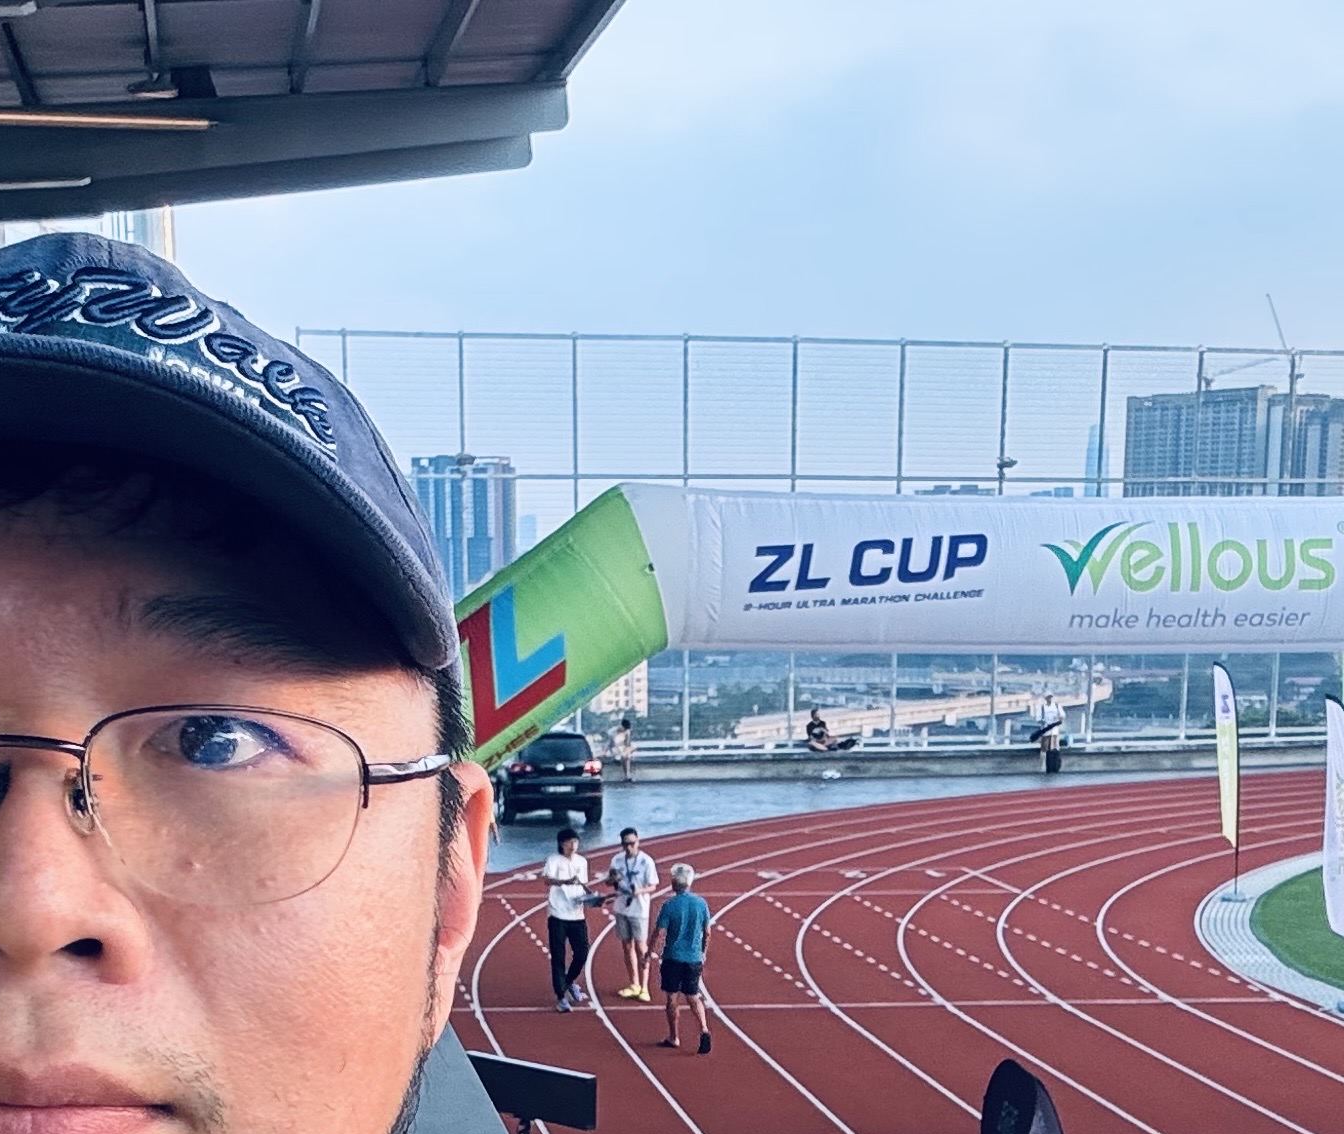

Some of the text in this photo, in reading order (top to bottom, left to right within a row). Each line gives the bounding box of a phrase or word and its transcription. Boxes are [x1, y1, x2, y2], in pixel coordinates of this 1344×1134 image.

[747, 533, 989, 594] ZL CUP
[1039, 520, 1336, 597] Wellous
[795, 598, 836, 609] ULTRA
[840, 593, 912, 606] MARATHON
[914, 588, 985, 602] CHALLENGE
[1068, 606, 1312, 629] make health easier
